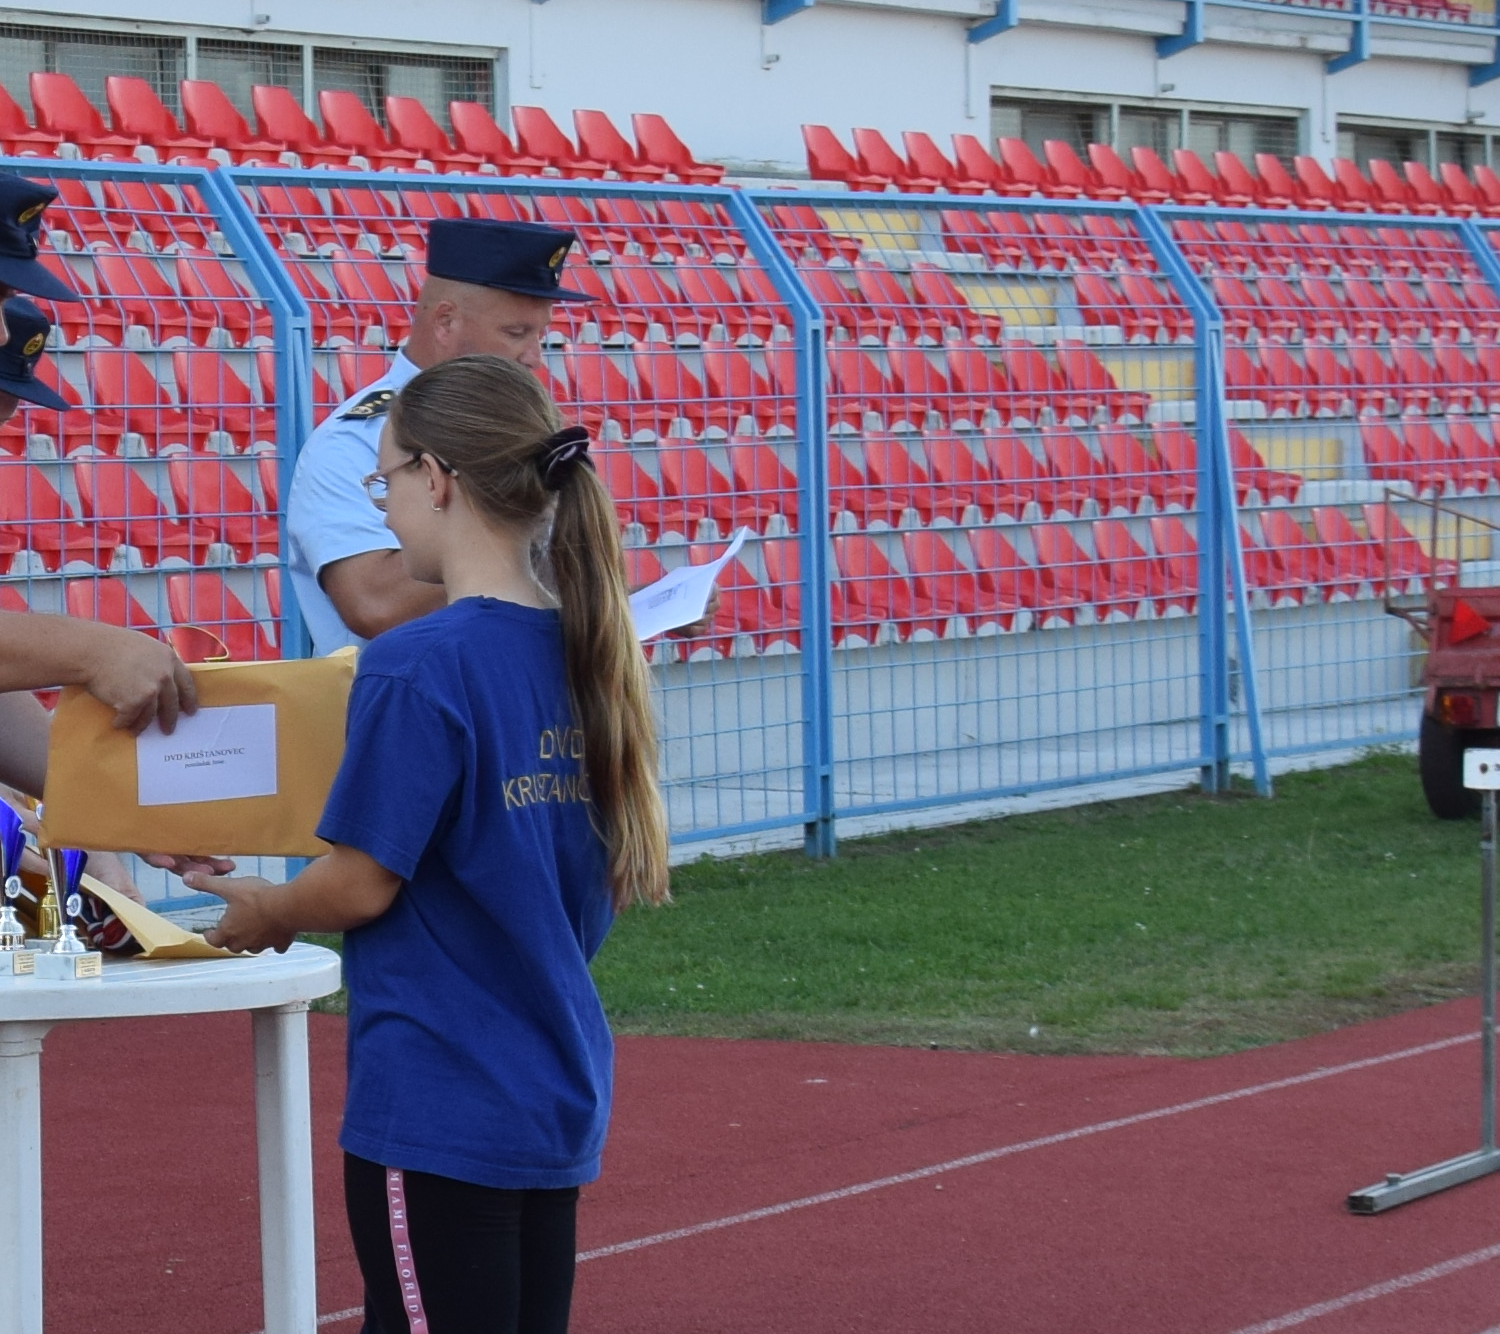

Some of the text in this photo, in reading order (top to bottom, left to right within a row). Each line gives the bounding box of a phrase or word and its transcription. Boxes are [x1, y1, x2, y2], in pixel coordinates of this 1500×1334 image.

[164, 753, 183, 763] DVD
[540, 725, 586, 759] DVD
[390, 1171, 405, 1229] MIAMI
[397, 1244, 423, 1325] FLORIDA
